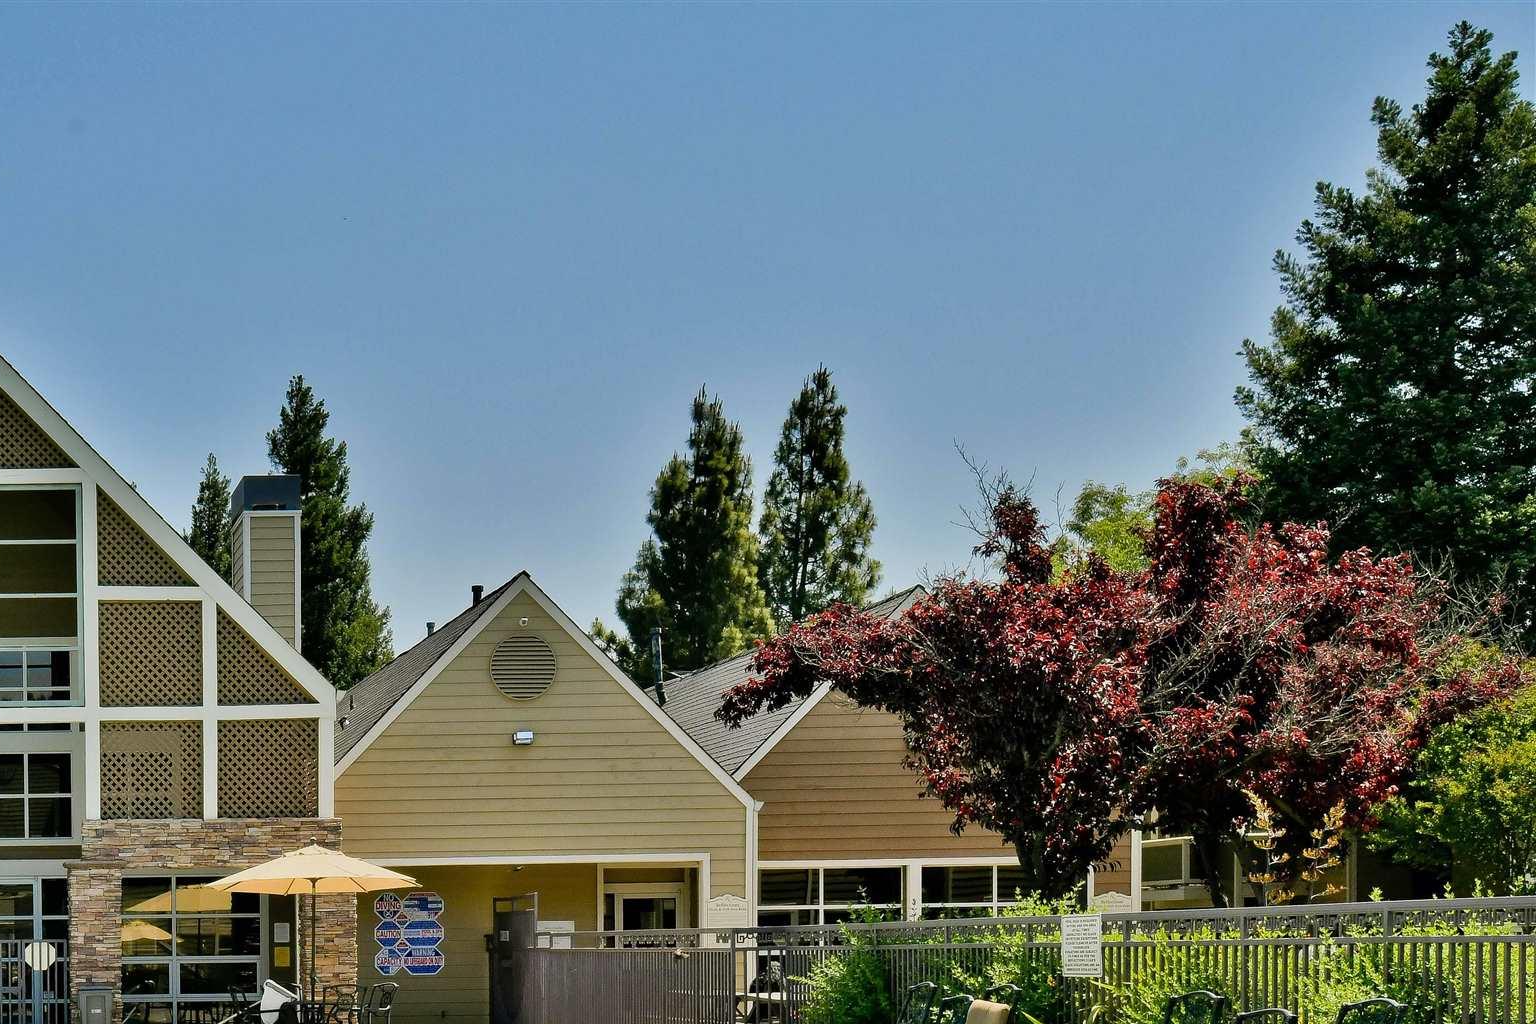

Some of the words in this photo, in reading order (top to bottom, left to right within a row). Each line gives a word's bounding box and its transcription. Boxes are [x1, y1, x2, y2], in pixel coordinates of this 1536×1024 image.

[376, 901, 401, 911] DIVING
[376, 930, 401, 938] CAUTION
[411, 948, 436, 956] WARNING
[377, 957, 402, 966] CAPACITY
